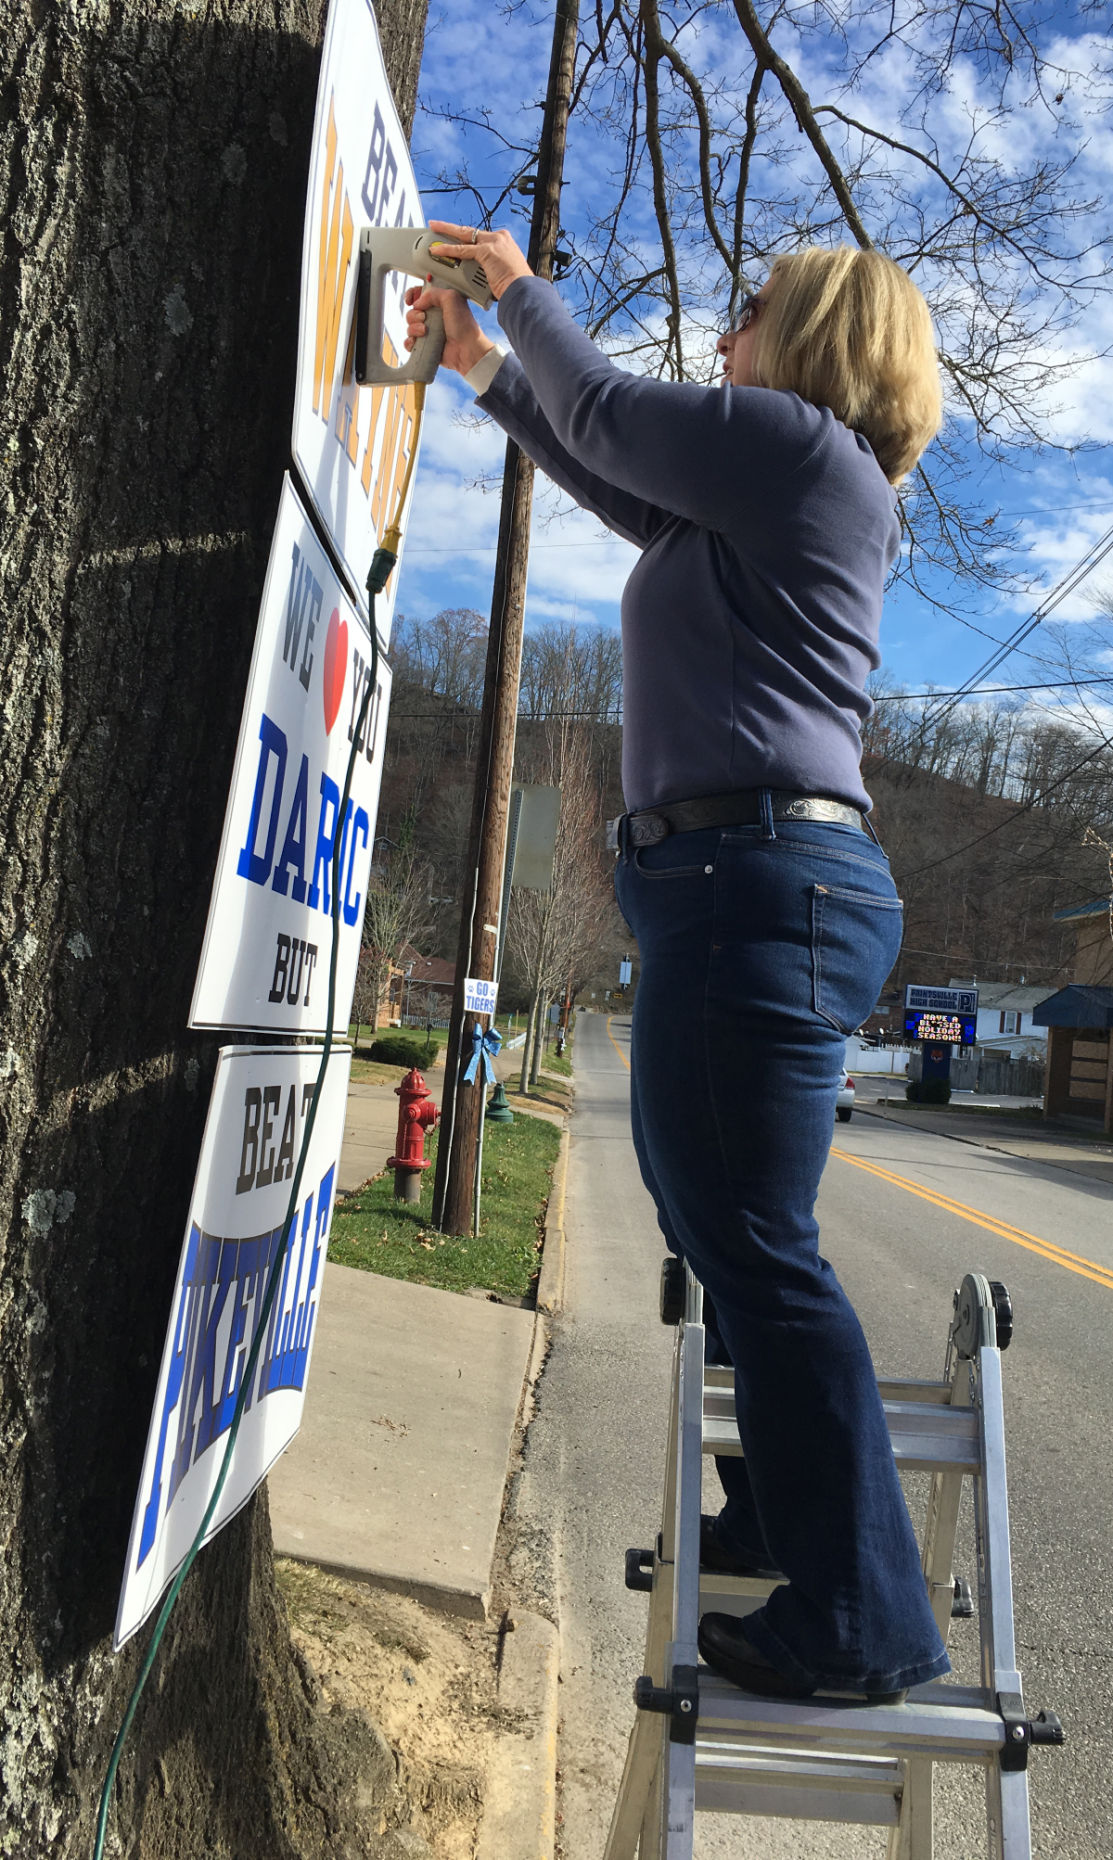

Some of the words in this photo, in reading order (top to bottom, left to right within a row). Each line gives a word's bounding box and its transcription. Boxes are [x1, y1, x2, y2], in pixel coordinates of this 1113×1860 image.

[361, 99, 420, 316] BE
[283, 541, 322, 692] WE
[269, 933, 318, 1006] BUT
[476, 981, 489, 996] GO
[466, 995, 495, 1013] TIGERS
[923, 1013, 948, 1021] HAVE
[918, 1026, 961, 1036] HOLIDAY
[235, 1083, 319, 1195] BEA
